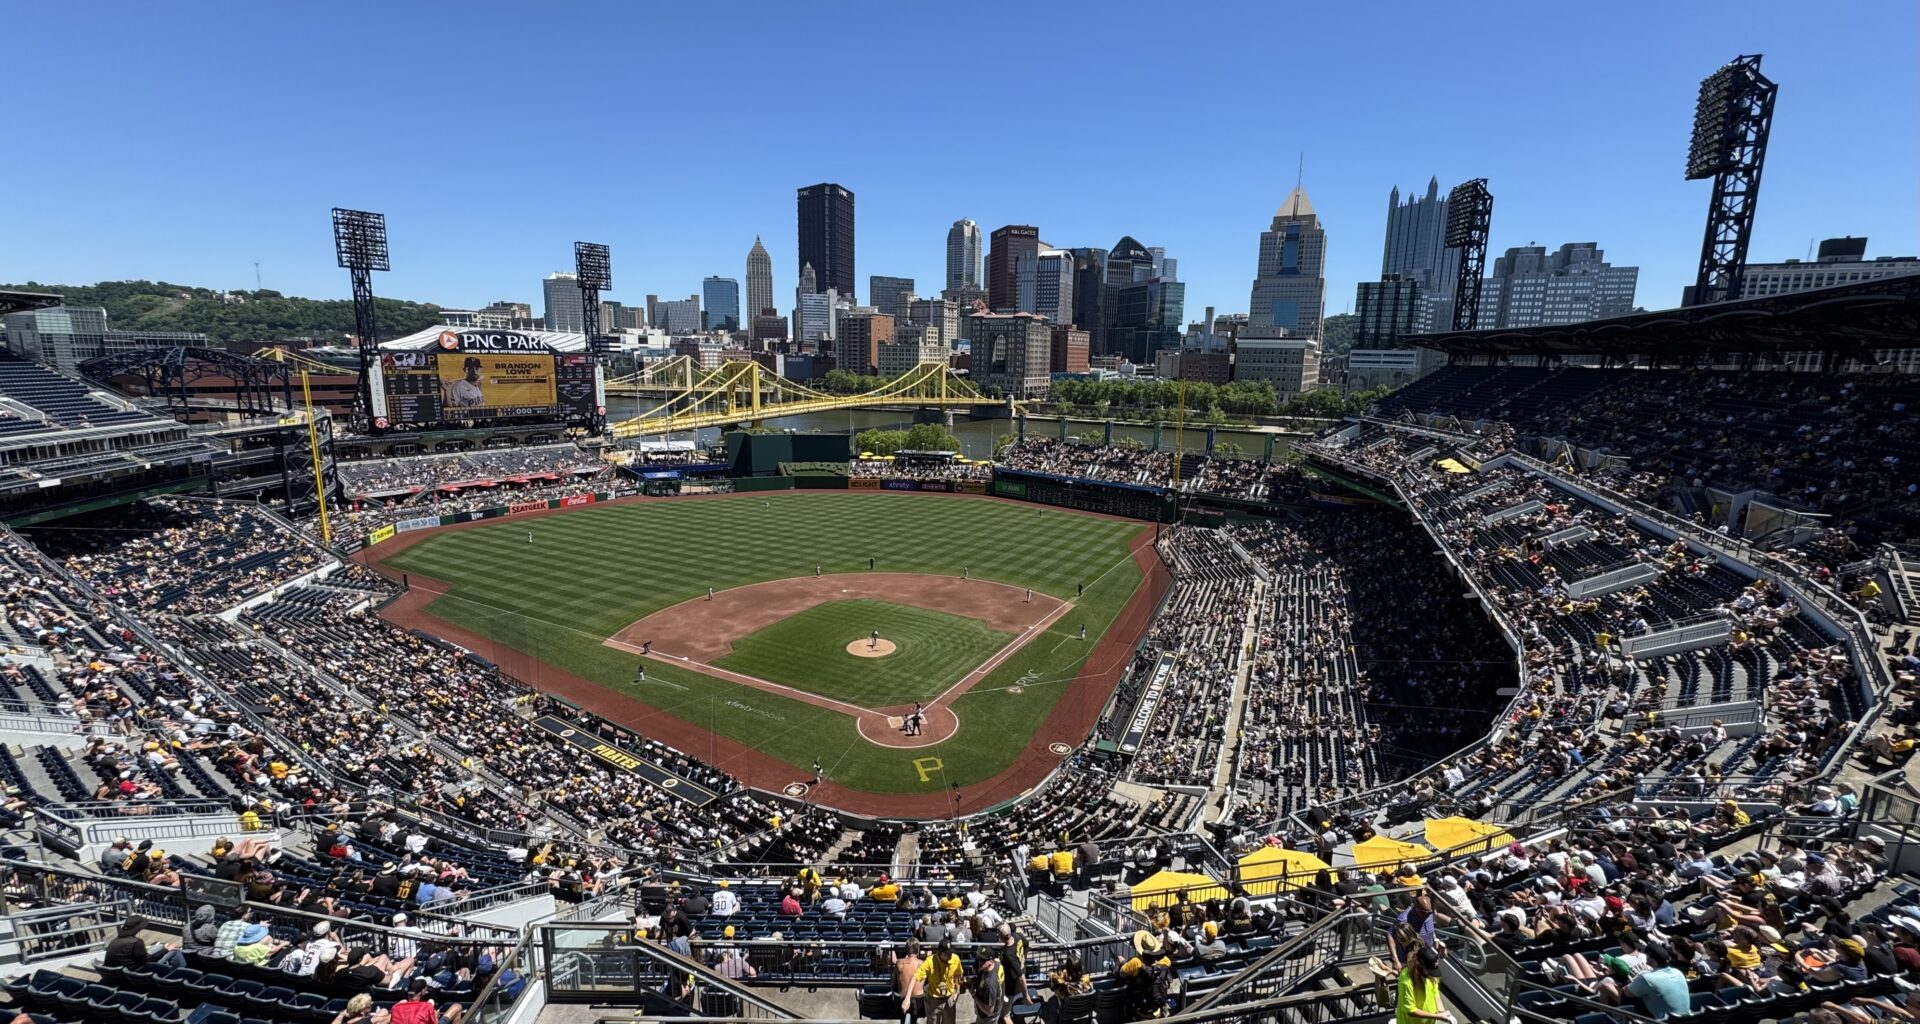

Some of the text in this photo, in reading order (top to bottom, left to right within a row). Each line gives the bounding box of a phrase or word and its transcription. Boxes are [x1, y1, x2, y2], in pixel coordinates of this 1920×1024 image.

[463, 334, 550, 350] PNC PARK
[888, 481, 910, 489] xfinity
[511, 502, 546, 514] SEATGEEK
[725, 700, 753, 712] xfinity
[1130, 699, 1155, 733] WELCOME
[1145, 690, 1159, 700] TO
[1152, 674, 1166, 687] PNC
[591, 744, 641, 769] PIRATES
[912, 756, 945, 782] P
[714, 900, 727, 911] 30
